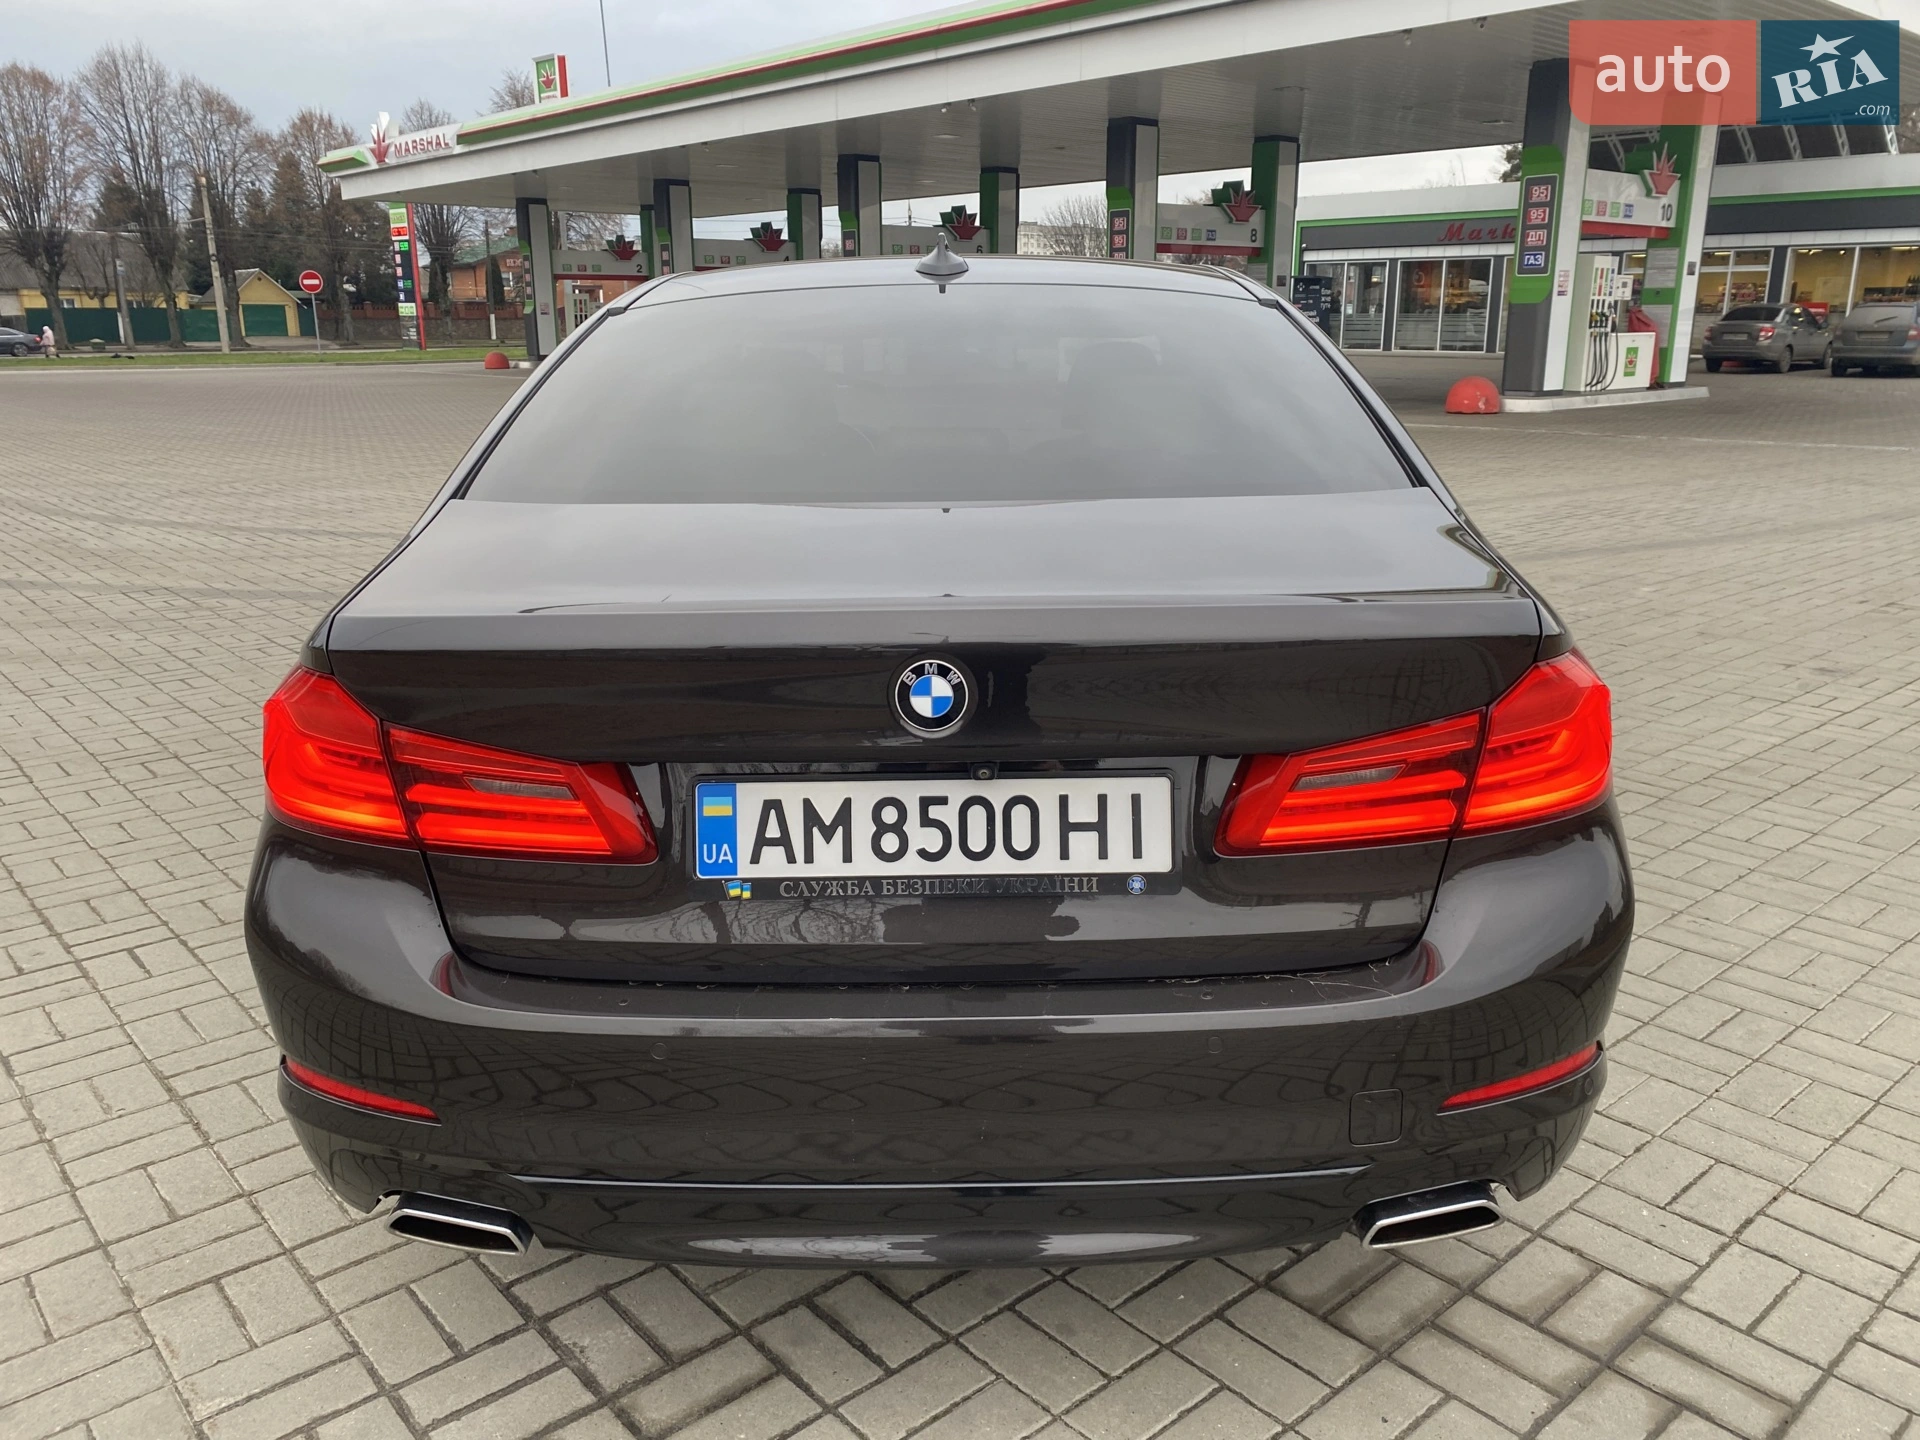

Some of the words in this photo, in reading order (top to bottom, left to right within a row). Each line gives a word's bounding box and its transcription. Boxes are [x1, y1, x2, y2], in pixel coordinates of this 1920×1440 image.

[393, 133, 452, 158] MARSHAL
[1531, 187, 1547, 198] 95
[1529, 210, 1545, 220] 95
[1661, 203, 1673, 222] 10
[1250, 228, 1258, 243] 8
[636, 264, 643, 274] 2
[1524, 255, 1542, 265] ГАЗ
[902, 663, 962, 686] BMW
[749, 797, 853, 864] AM
[870, 794, 1040, 864] 8500
[1058, 793, 1143, 861] HI
[703, 844, 733, 864] UA
[779, 880, 875, 898] СЛУЖБА
[881, 877, 989, 897] БЕЗПЕКИ
[995, 875, 1099, 896] УКРАЇНИ
